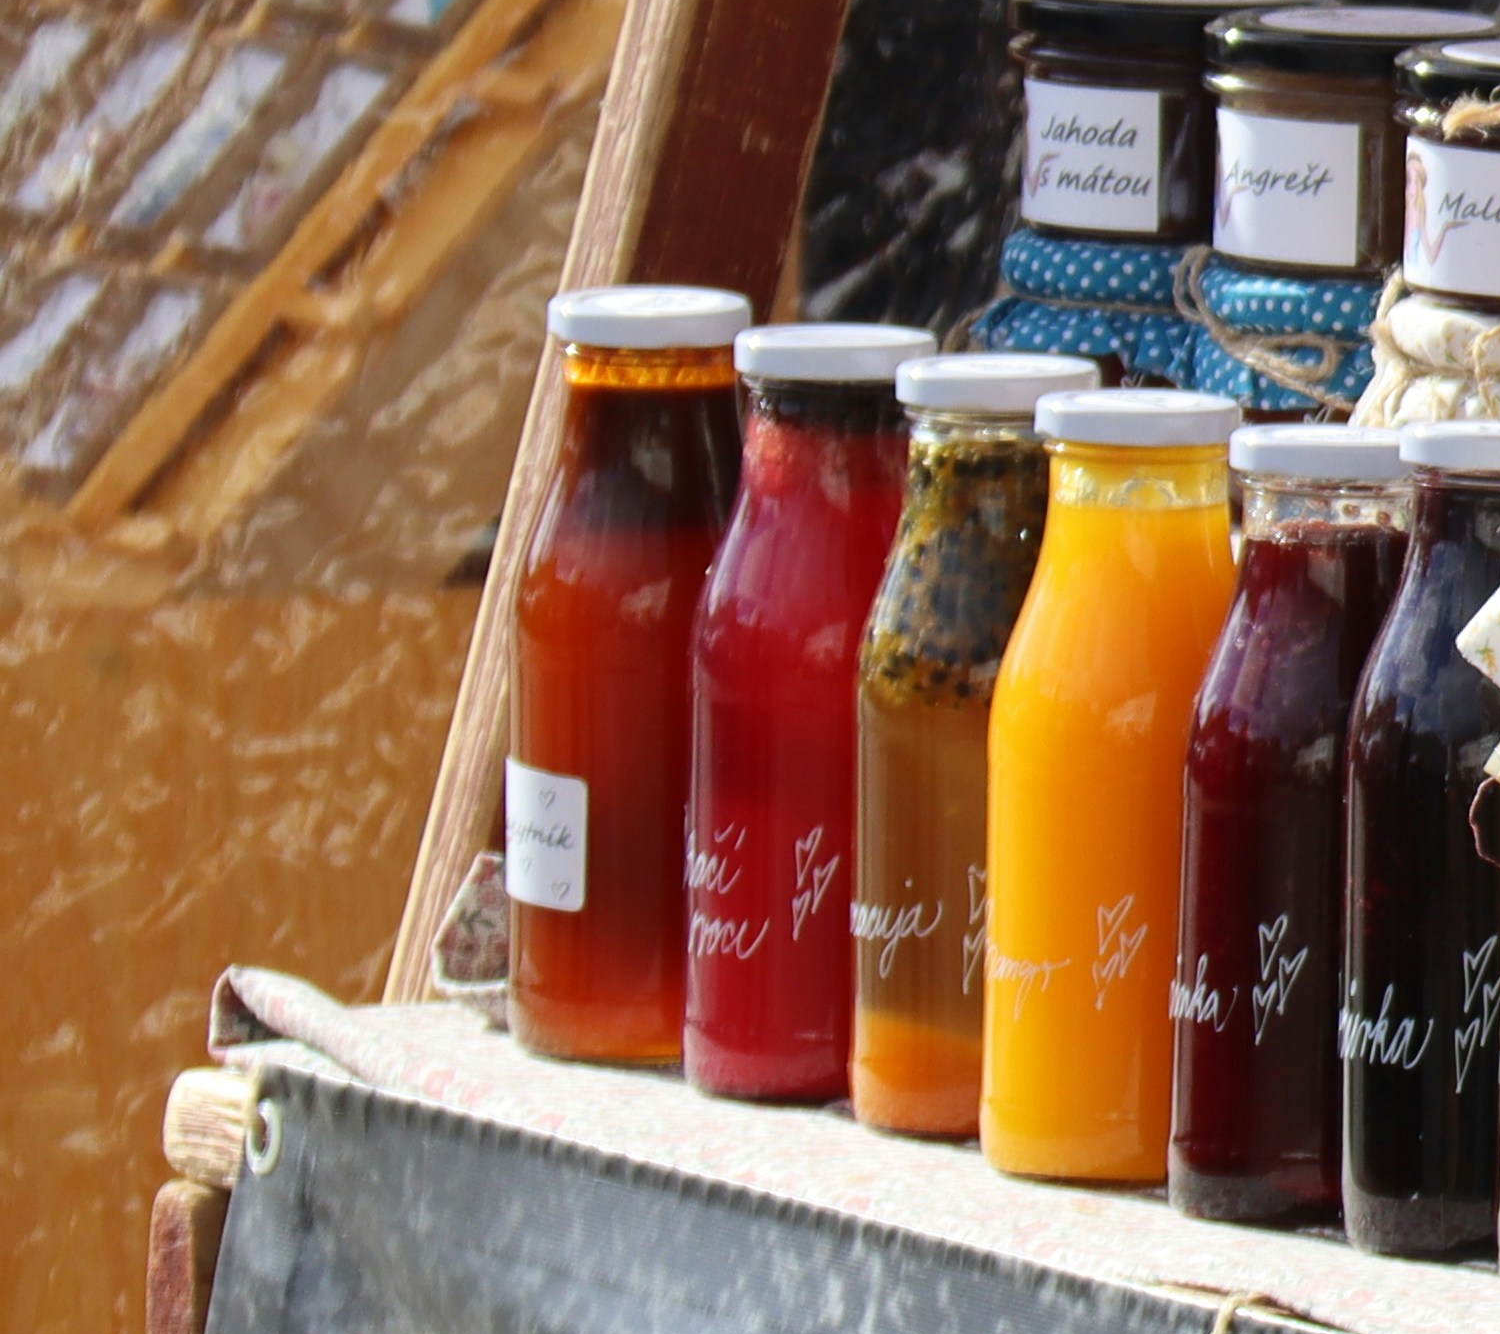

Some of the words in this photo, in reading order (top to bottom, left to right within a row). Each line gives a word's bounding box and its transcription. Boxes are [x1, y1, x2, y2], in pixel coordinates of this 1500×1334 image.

[1040, 115, 1138, 149] Jahoda
[1056, 163, 1152, 197] mátou
[1224, 161, 1333, 195] Angrešt
